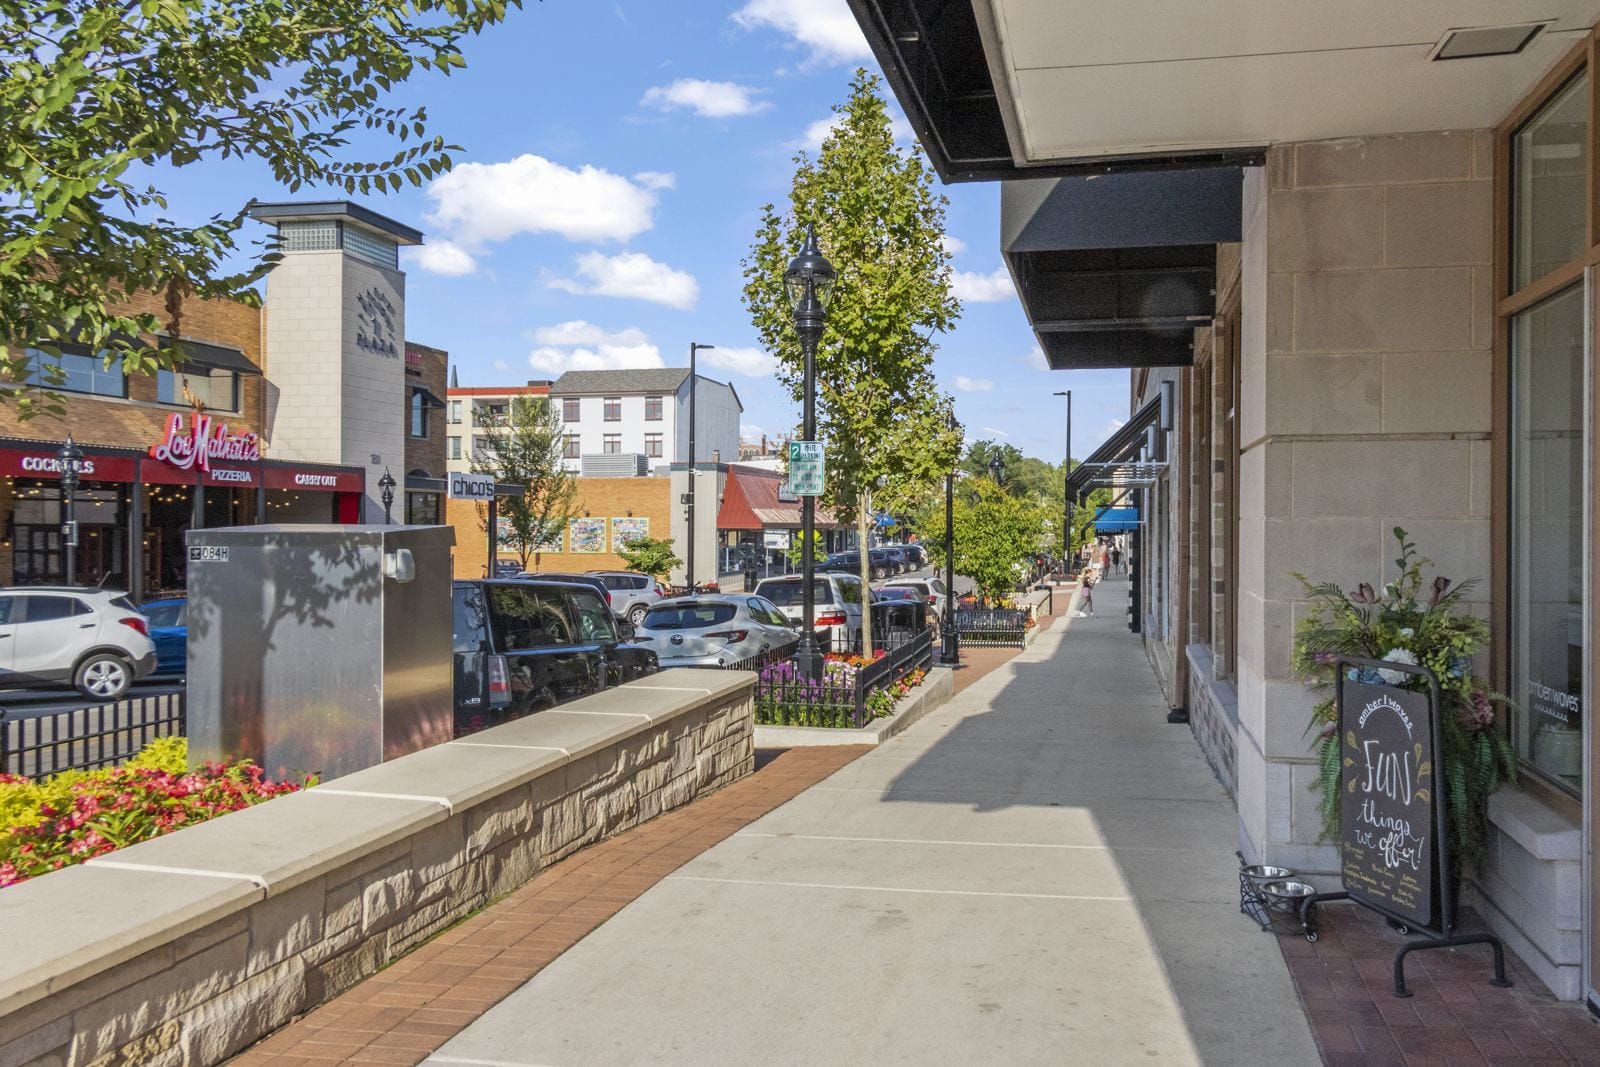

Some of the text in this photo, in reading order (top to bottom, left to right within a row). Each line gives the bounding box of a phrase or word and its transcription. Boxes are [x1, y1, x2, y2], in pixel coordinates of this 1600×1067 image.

[153, 412, 260, 472] Lou Malnati's
[791, 446, 800, 459] 2
[211, 469, 252, 482] PIZZERIA
[295, 473, 337, 487] CARRY OUT
[453, 477, 494, 496] chico's
[203, 547, 228, 559] 084H
[1362, 740, 1411, 806] FUN
[1356, 799, 1420, 847] things
[1354, 829, 1376, 849] we
